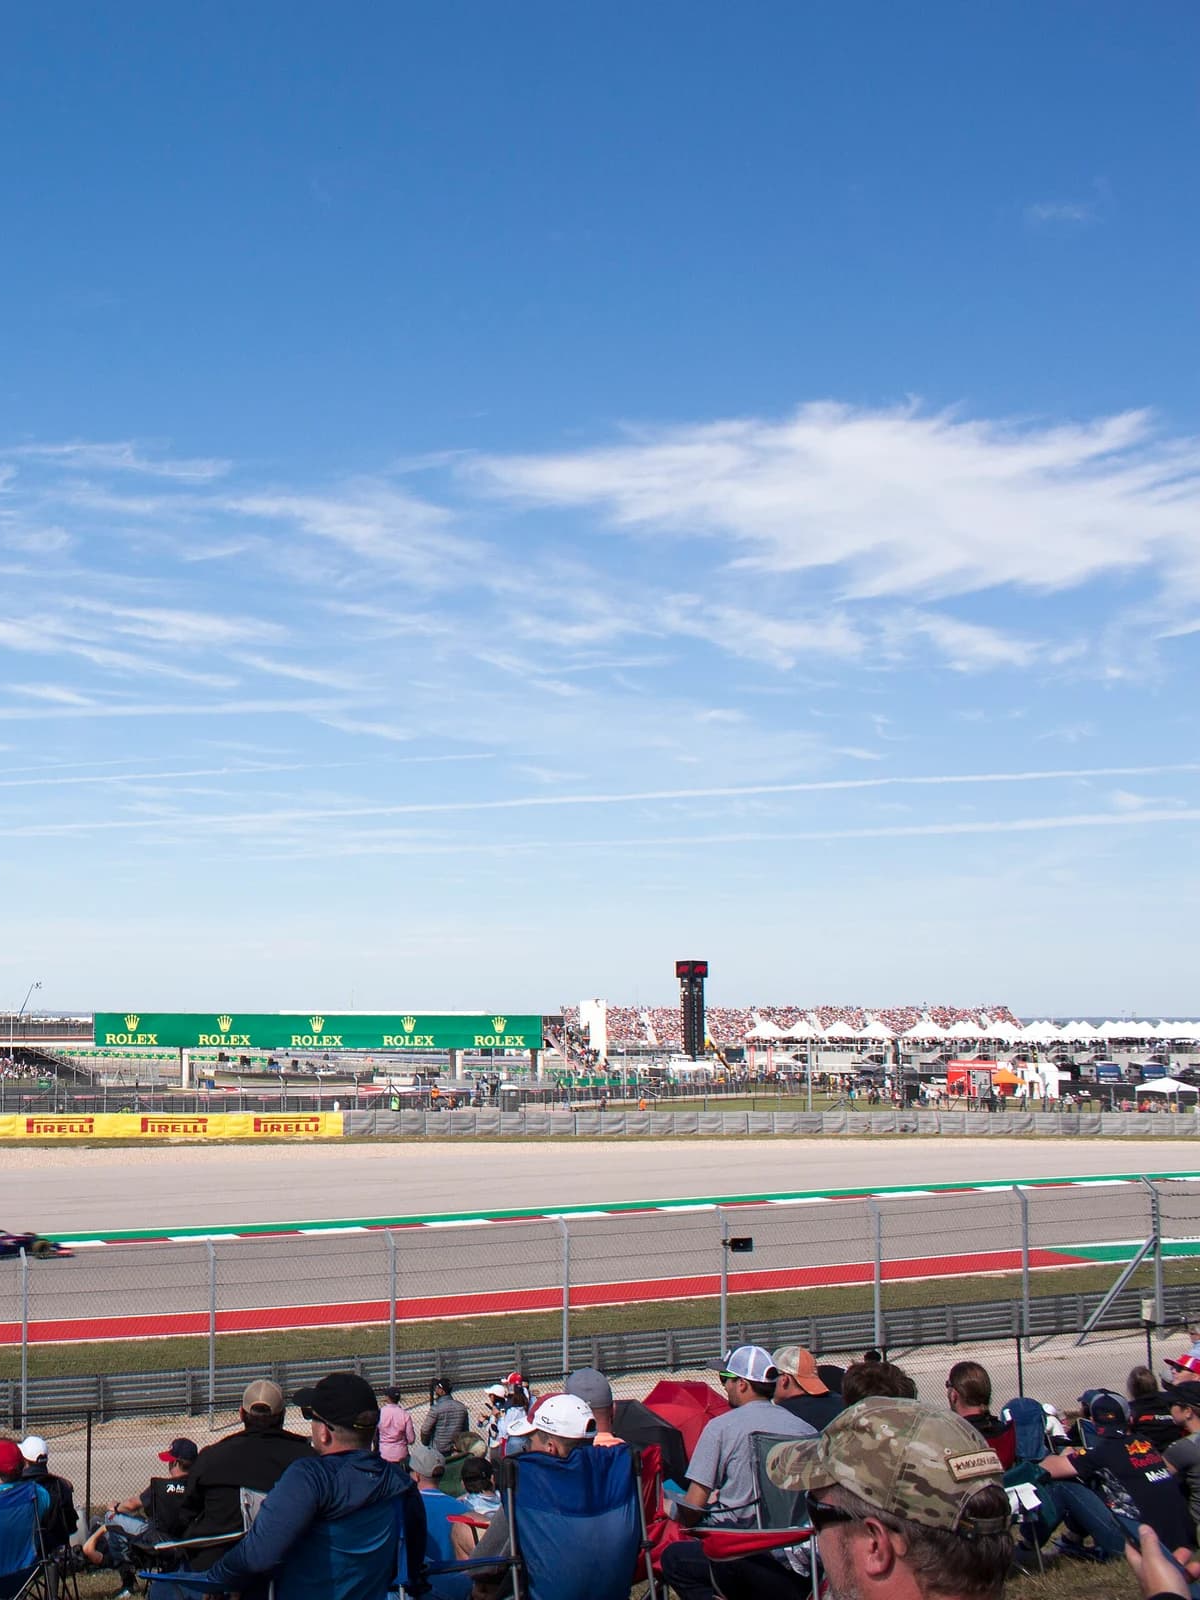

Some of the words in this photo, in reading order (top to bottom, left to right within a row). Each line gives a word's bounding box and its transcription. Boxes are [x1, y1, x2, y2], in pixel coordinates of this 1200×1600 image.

[106, 1034, 158, 1045] ROLEX
[199, 1034, 251, 1046] ROLEX
[291, 1035, 343, 1046] ROLEX
[383, 1036, 434, 1046] ROLEX
[474, 1036, 525, 1047] ROLEX
[26, 1118, 95, 1133] PIRELLI
[141, 1117, 209, 1133] PIRELLI
[254, 1117, 320, 1133] PIRELLI
